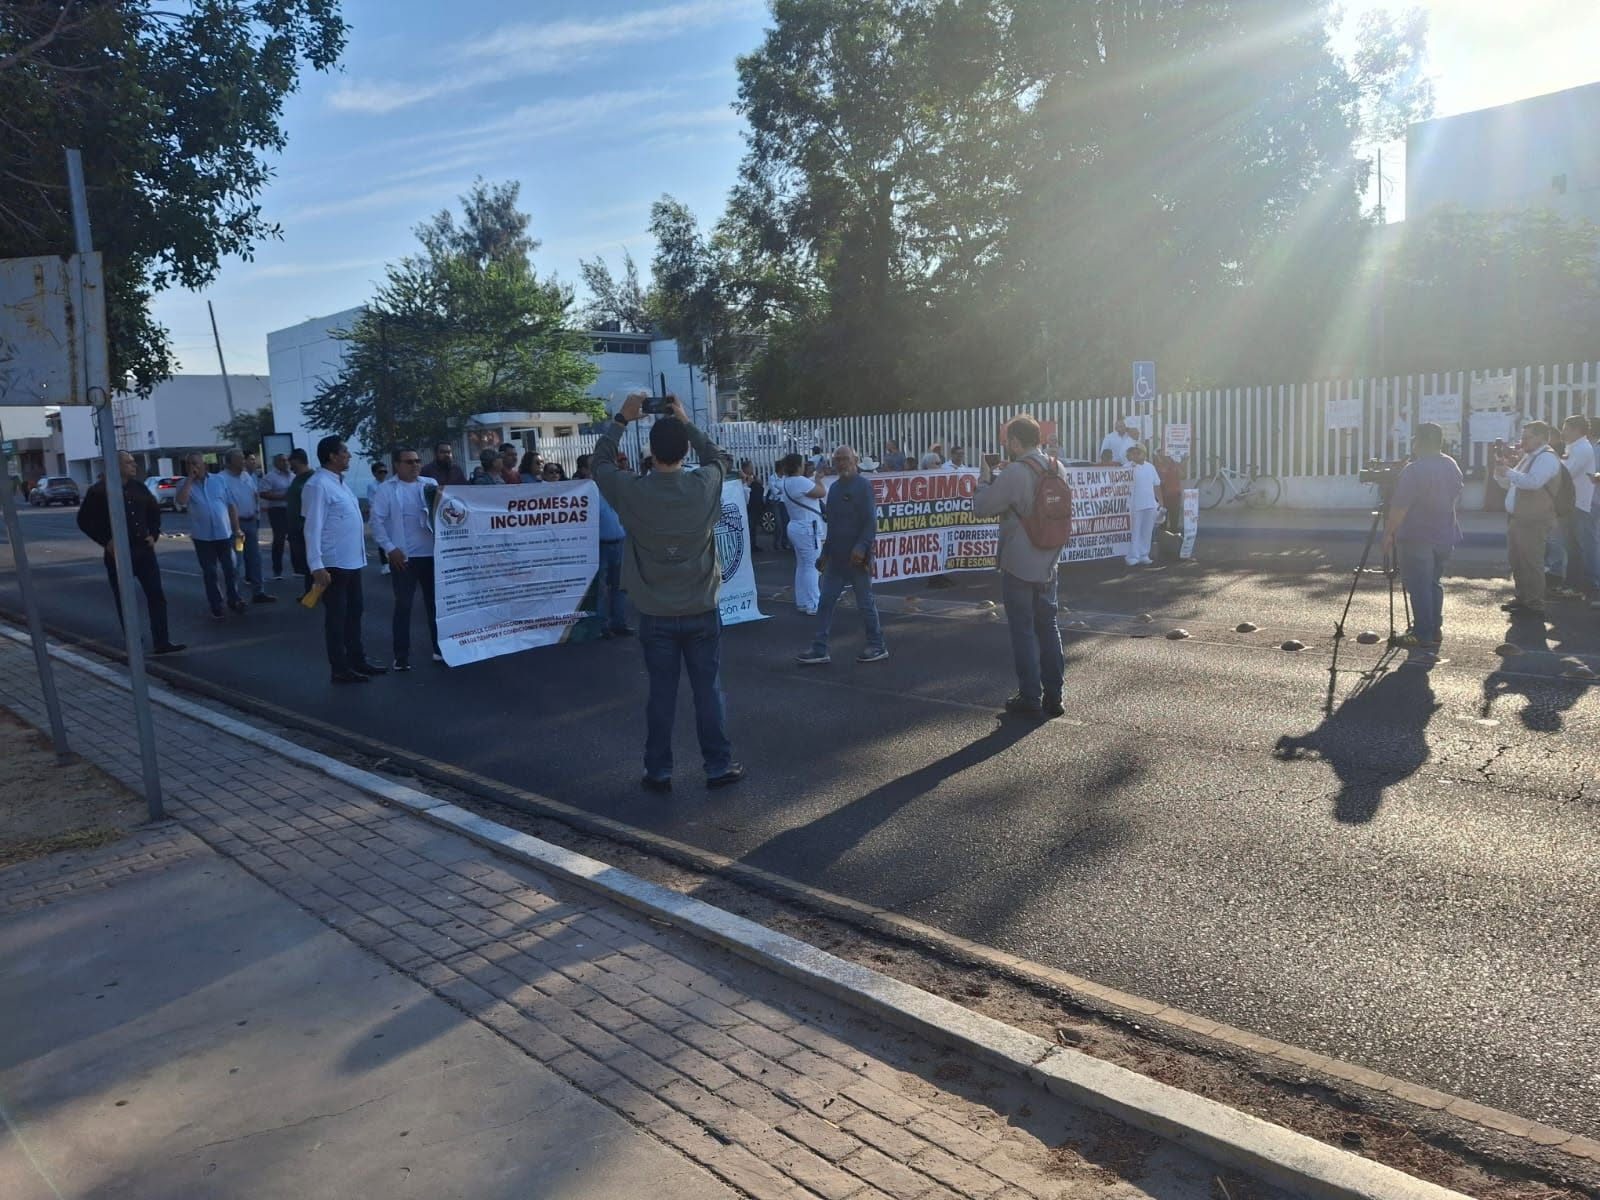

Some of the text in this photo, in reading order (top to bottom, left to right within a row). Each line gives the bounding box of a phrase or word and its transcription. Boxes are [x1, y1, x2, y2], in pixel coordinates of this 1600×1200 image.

[1077, 472, 1085, 485] EL
[1086, 472, 1101, 485] PAN
[1102, 471, 1108, 483] Y
[871, 474, 977, 503] EXIGIMO
[508, 496, 589, 512] PROMESAS
[888, 503, 932, 517] FECHA
[892, 516, 926, 531] NUEVA
[958, 540, 998, 556] ISSST
[883, 558, 898, 578] LA
[902, 554, 942, 575] CARA.
[968, 557, 996, 568] ESCOND
[720, 600, 751, 617] ción 47
